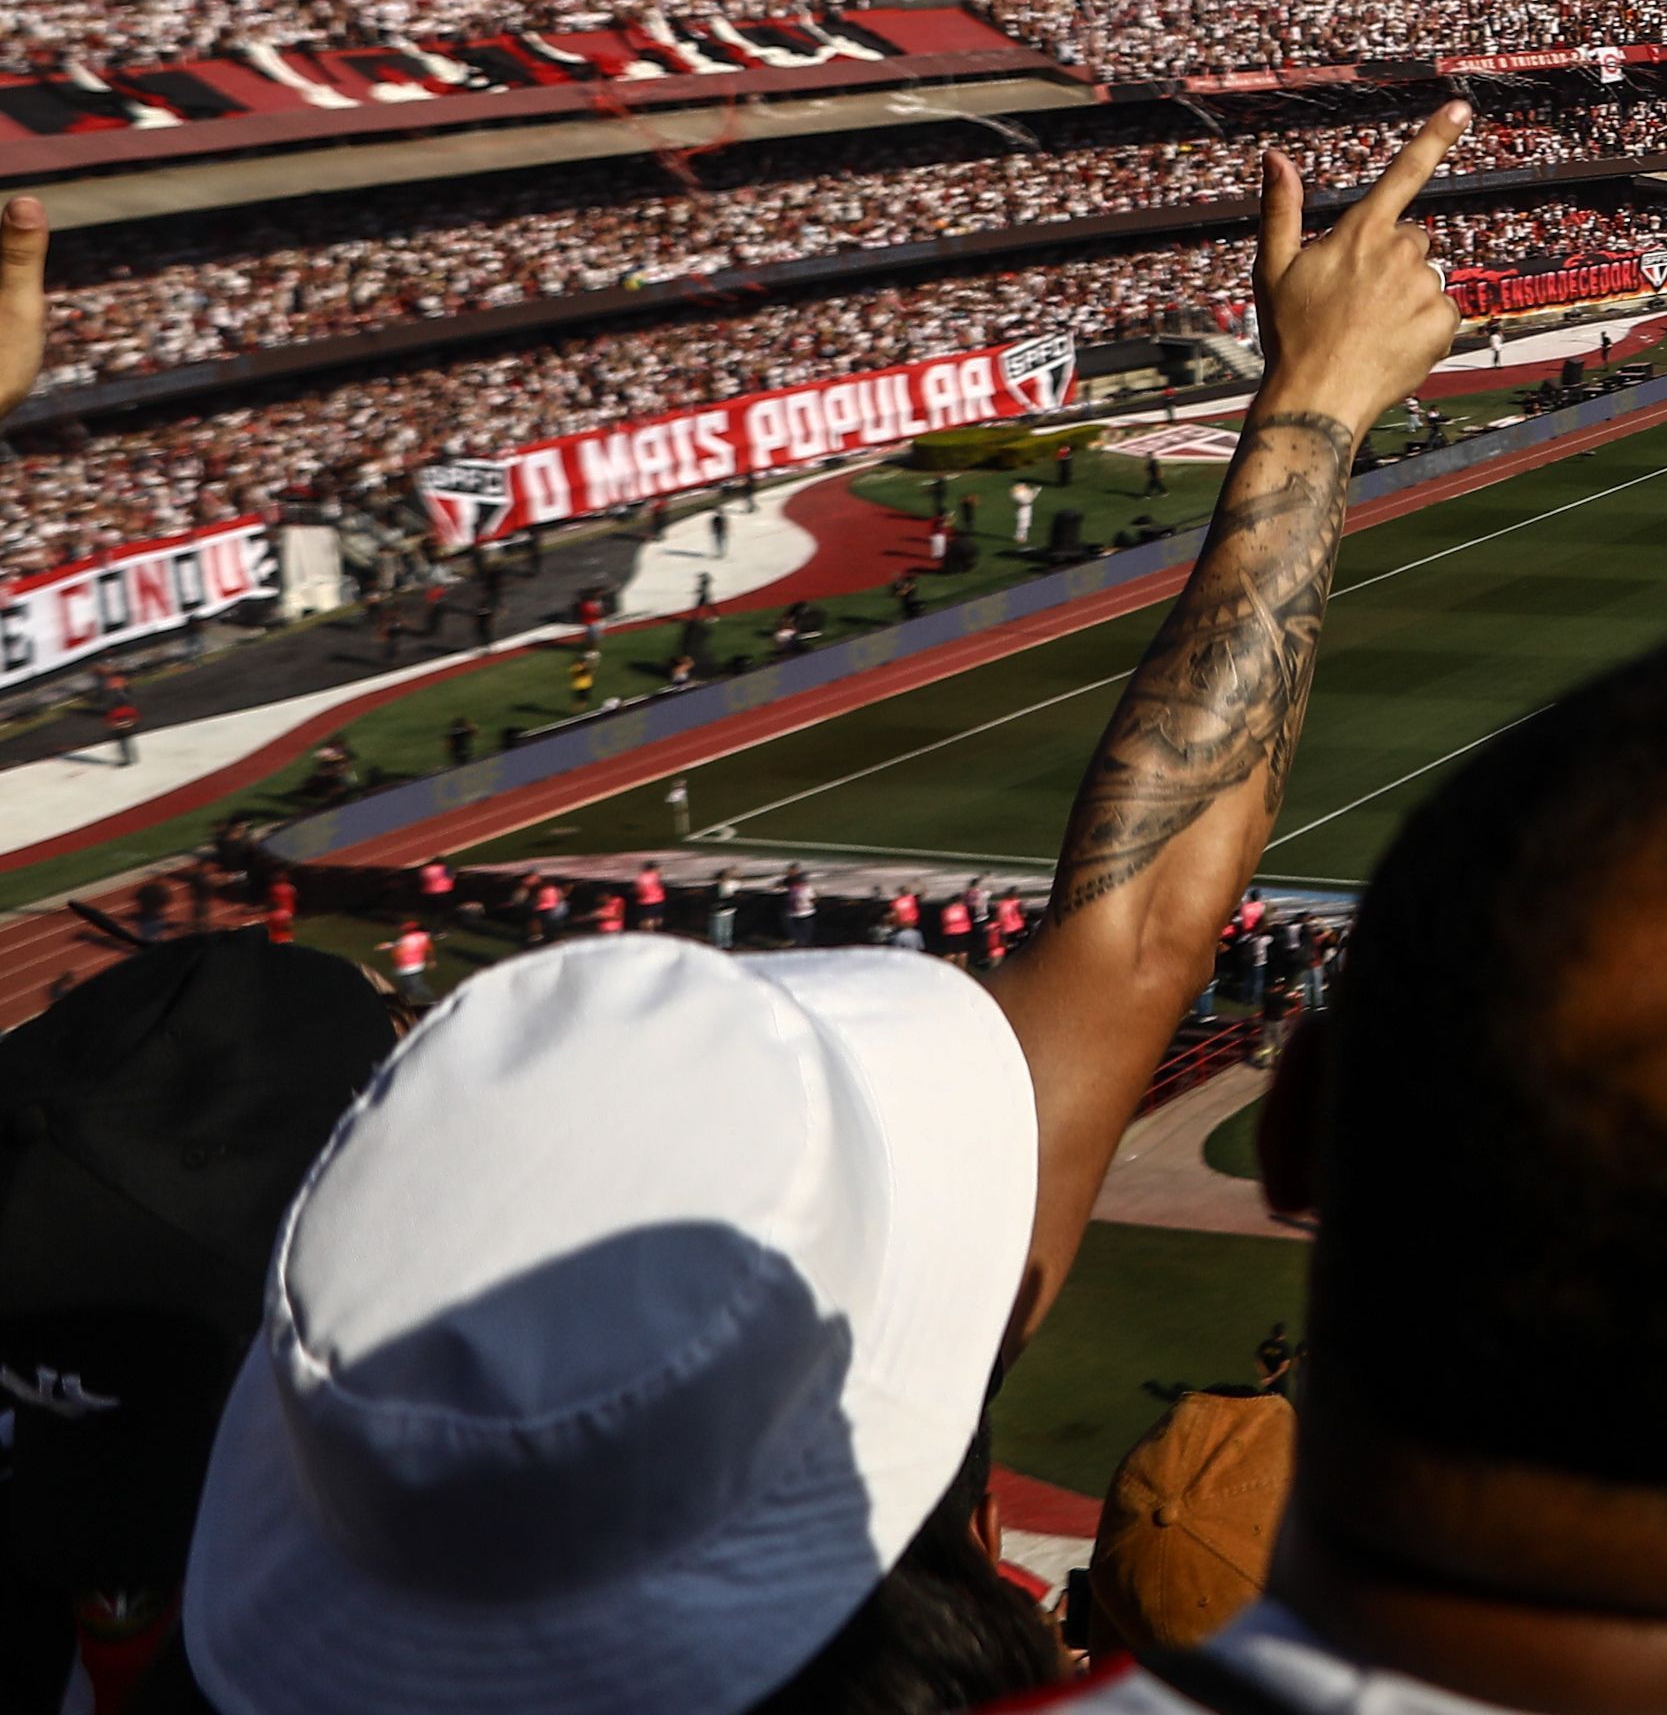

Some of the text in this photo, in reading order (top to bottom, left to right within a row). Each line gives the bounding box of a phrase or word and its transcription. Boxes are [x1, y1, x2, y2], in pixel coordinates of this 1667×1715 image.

[514, 355, 999, 524] O MAIS POPULAR
